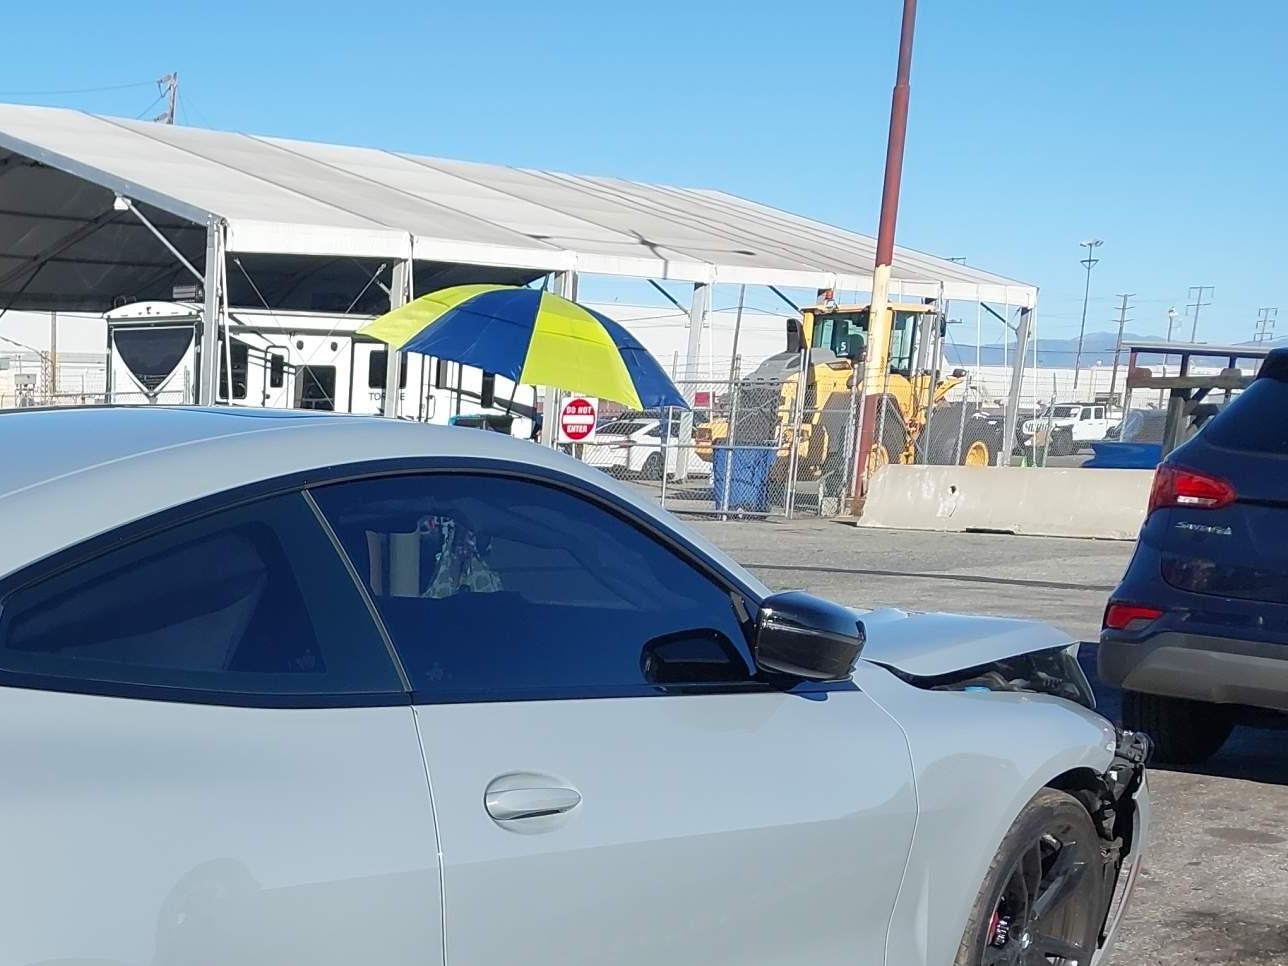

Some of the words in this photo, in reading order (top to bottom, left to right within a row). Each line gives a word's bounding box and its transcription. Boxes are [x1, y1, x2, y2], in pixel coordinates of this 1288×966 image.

[840, 342, 847, 351] 5
[368, 392, 405, 401] TORE
[566, 406, 577, 414] DO
[578, 406, 592, 414] NOT
[566, 425, 588, 433] ENTER
